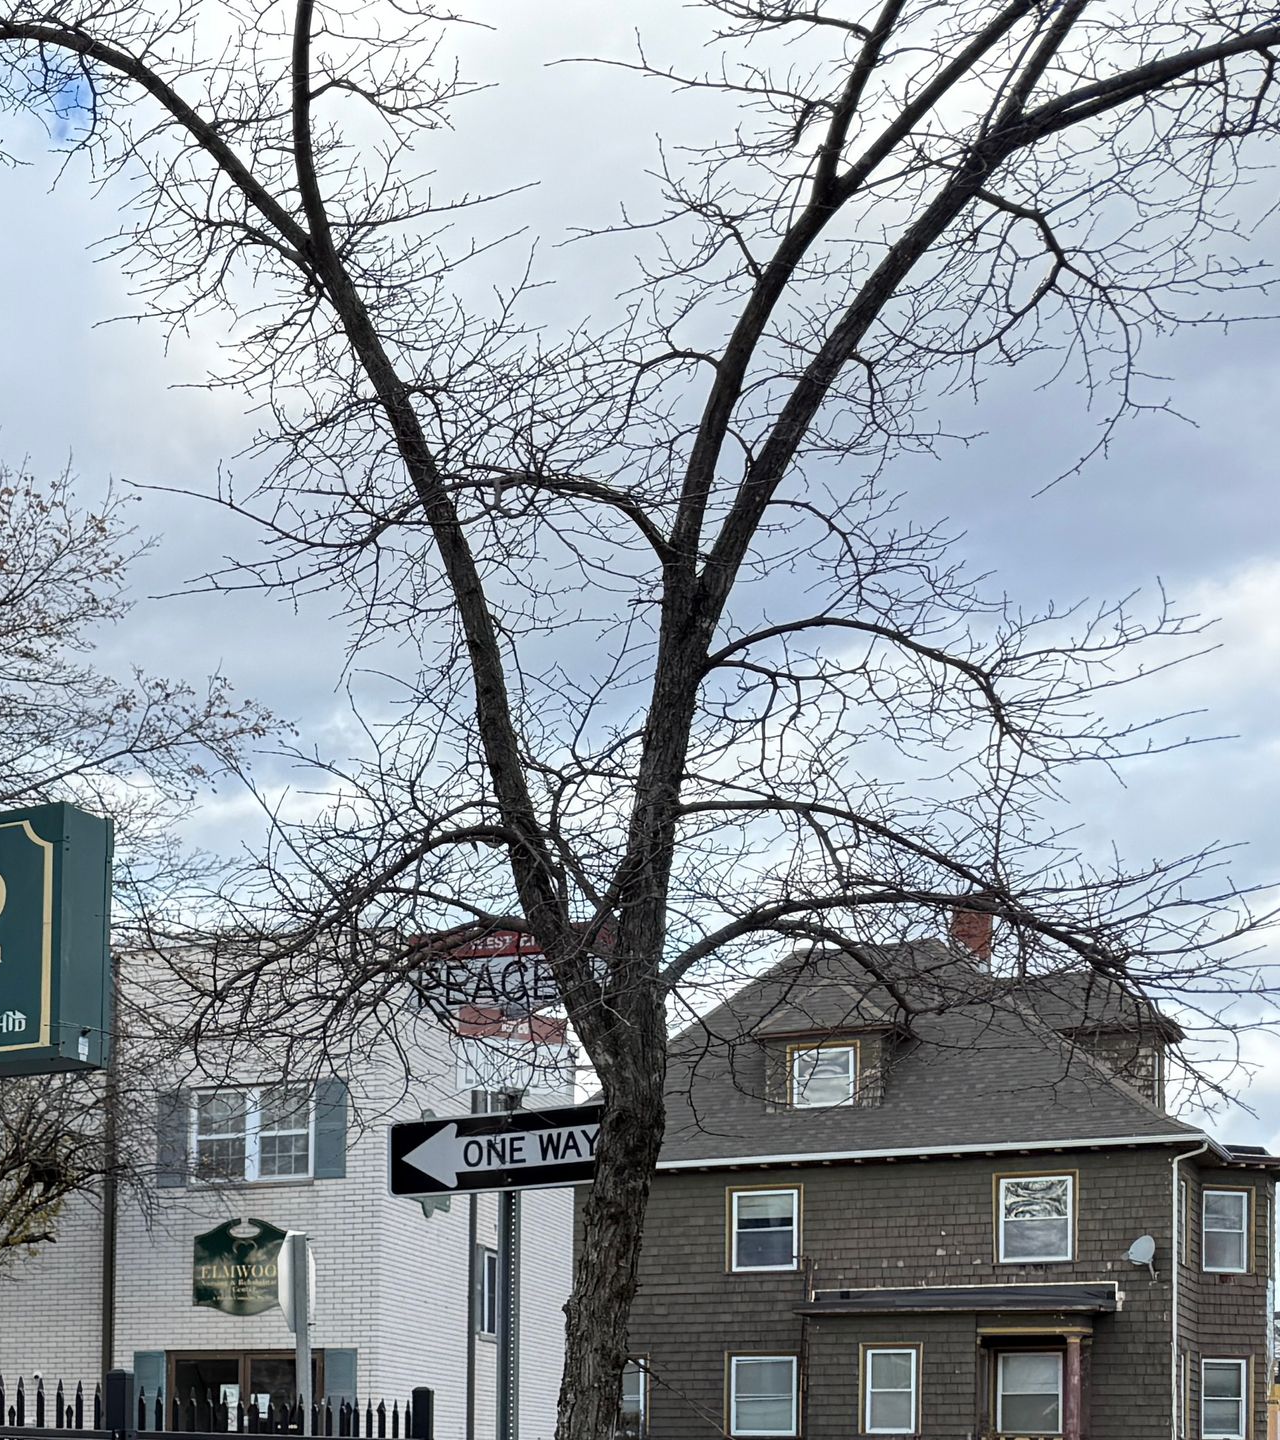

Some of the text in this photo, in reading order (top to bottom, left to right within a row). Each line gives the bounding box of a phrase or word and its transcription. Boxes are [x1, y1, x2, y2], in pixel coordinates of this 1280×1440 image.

[463, 1130, 601, 1168] ONE WAY
[201, 1264, 277, 1279] ELMWOO
